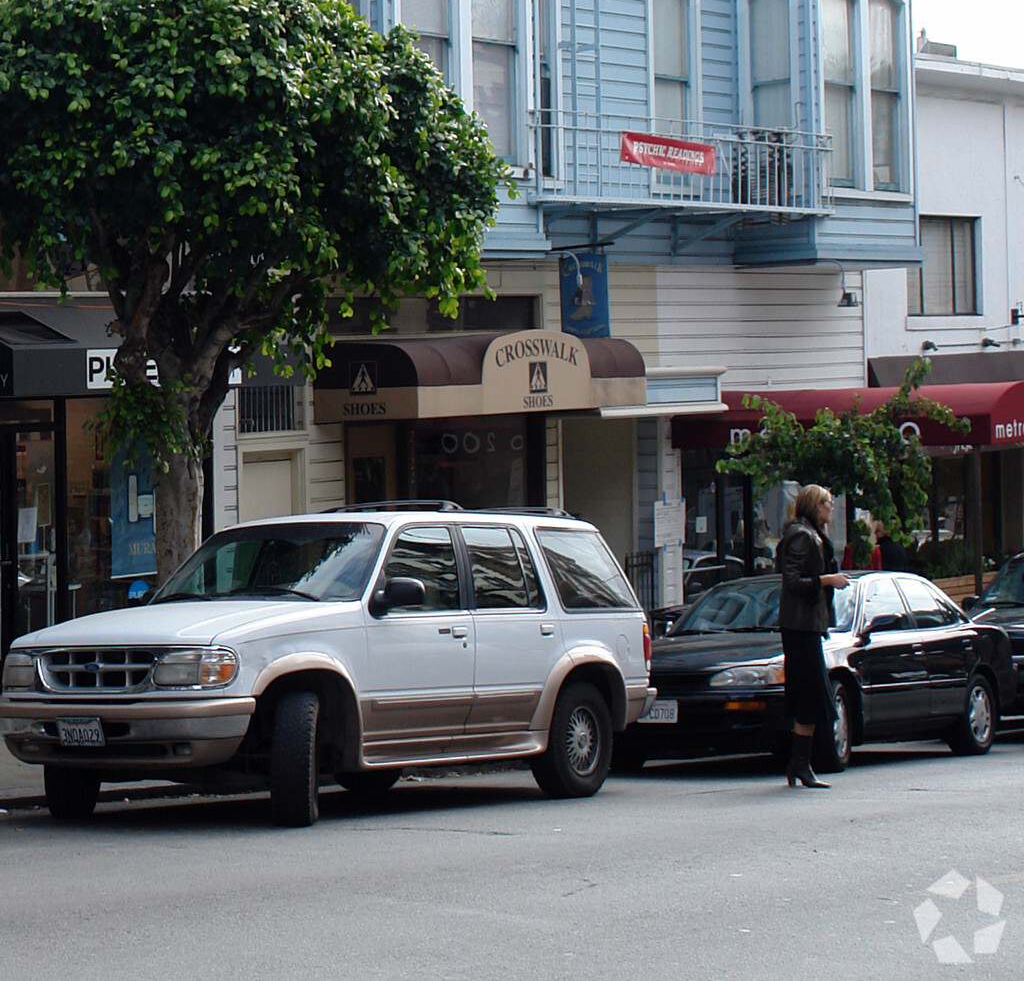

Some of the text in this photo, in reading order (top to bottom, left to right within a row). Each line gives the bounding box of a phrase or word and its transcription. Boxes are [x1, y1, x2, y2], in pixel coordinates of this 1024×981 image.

[632, 140, 705, 164] PSYCHIC READINGS
[494, 338, 580, 368] CROSSWALK
[343, 401, 387, 417] SHOES
[522, 394, 554, 409] SHOES
[995, 418, 1024, 439] metr
[128, 541, 157, 556] MURA
[128, 590, 148, 600] PUR
